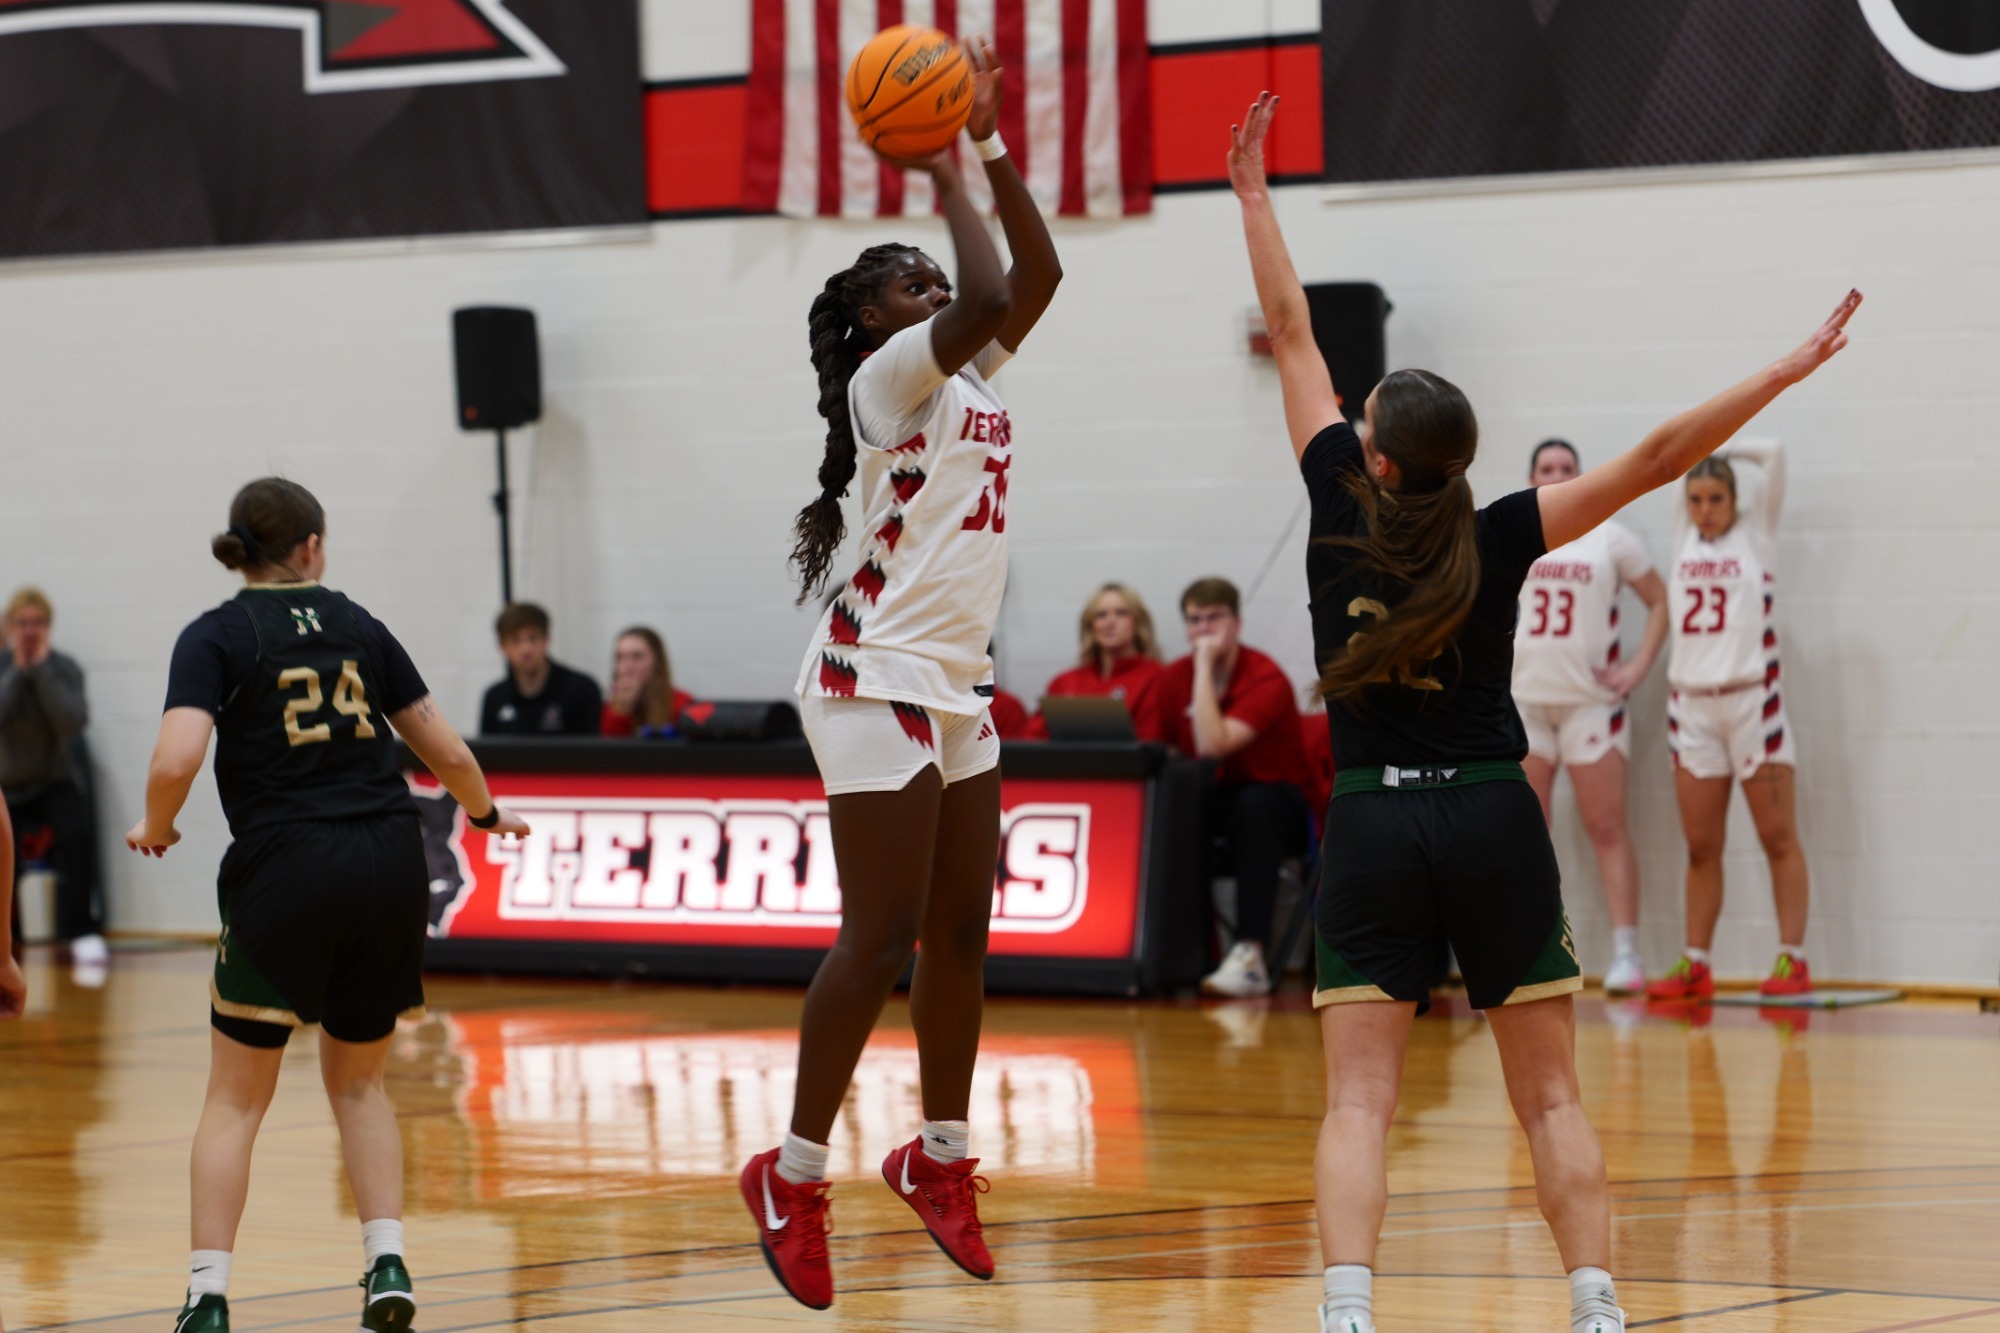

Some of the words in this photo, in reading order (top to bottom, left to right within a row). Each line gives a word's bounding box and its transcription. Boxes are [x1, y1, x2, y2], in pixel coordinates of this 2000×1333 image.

[1529, 588, 1575, 636] 33
[1682, 587, 1728, 633] 23
[277, 659, 376, 747] 24
[487, 797, 1091, 933] TERRIS
